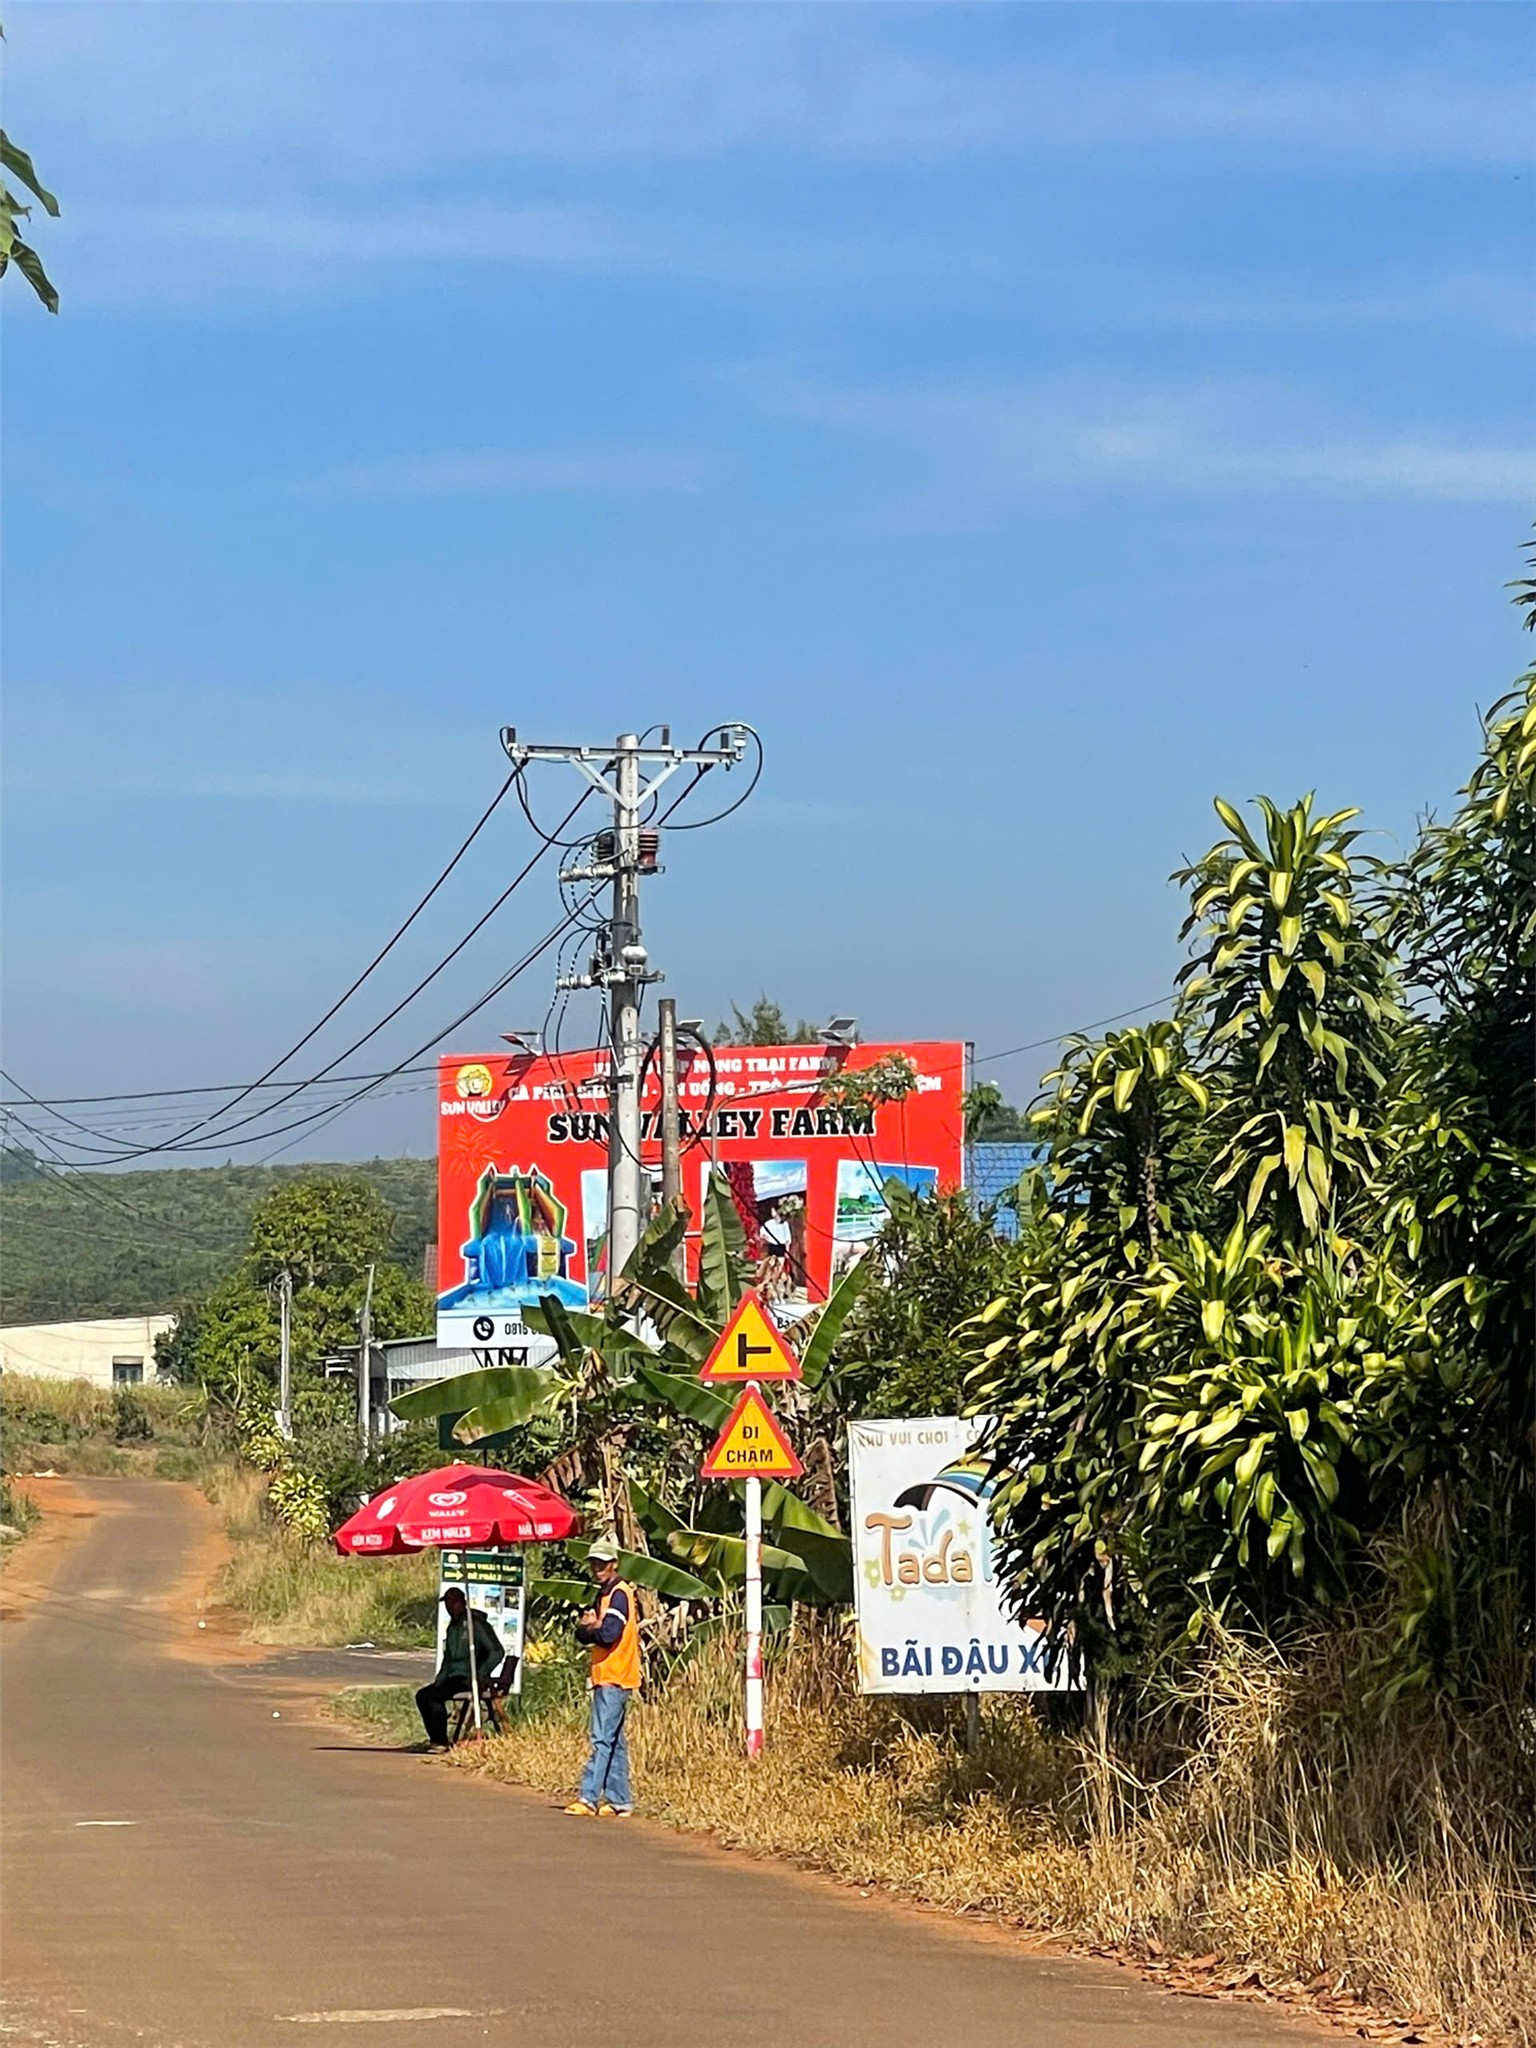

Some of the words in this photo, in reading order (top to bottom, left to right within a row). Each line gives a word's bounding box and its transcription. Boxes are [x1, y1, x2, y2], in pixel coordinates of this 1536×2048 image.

[640, 1108, 764, 1140] VLLEY
[742, 1425, 759, 1440] ĐI
[889, 1431, 911, 1446] VUI
[864, 1512, 973, 1586] Tada
[881, 1638, 933, 1677] BÃI
[941, 1638, 1009, 1684] ĐẬU
